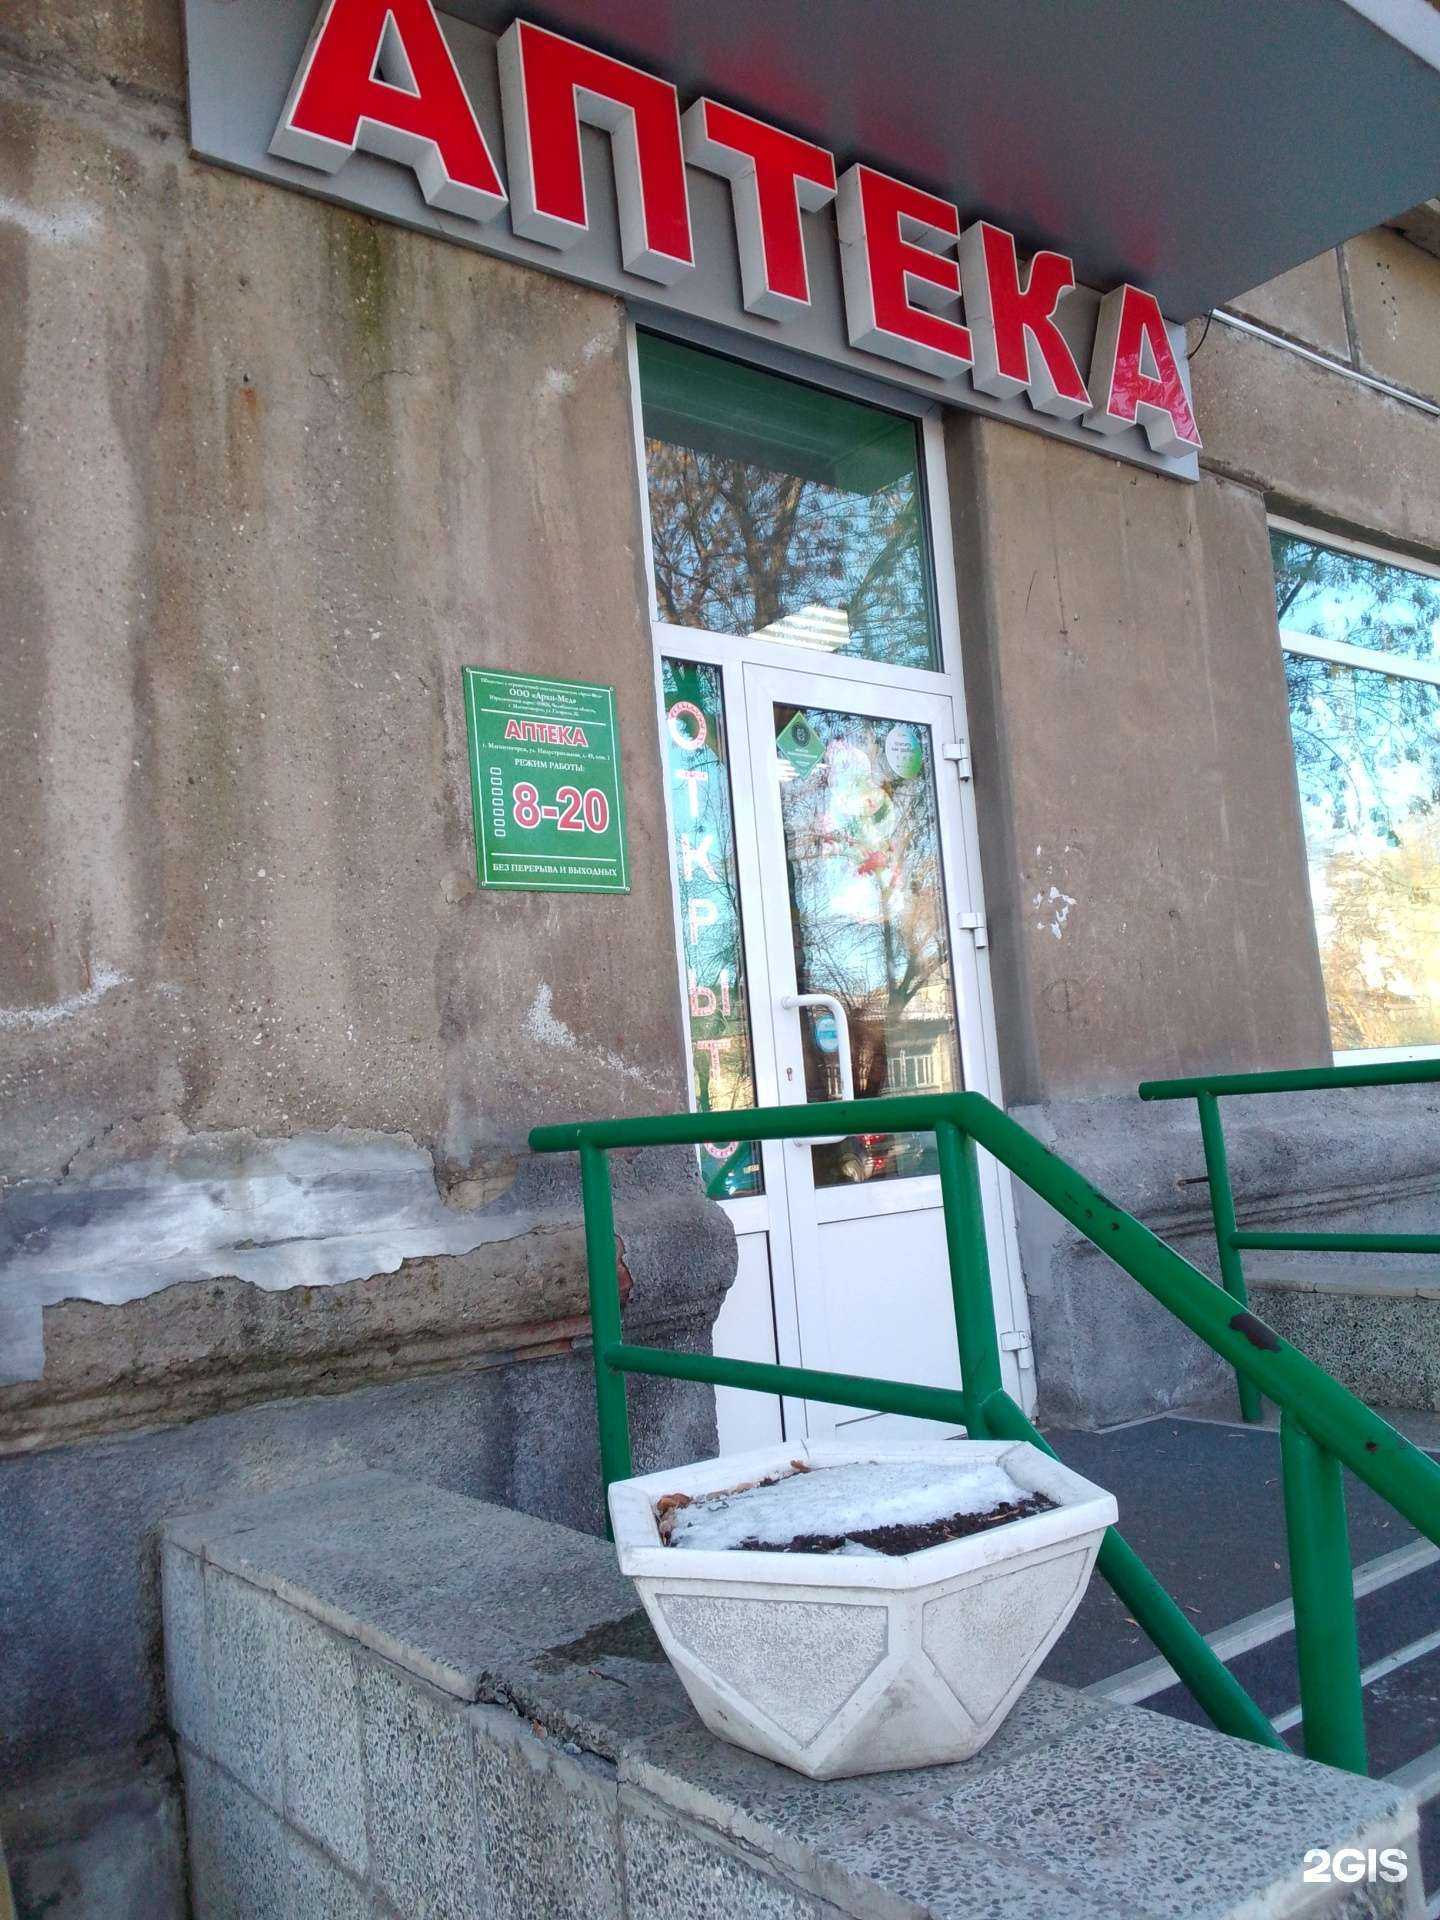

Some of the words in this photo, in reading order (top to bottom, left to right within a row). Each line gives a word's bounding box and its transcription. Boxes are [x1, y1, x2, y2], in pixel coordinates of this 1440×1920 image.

[269, 0, 1202, 457] АПТЕКА
[509, 688, 530, 698] ООО
[505, 719, 589, 747] АПТЕКА
[514, 758, 547, 769] РЕЖИМ
[512, 781, 610, 834] 8-20
[493, 863, 510, 872] БЕЗ
[511, 864, 559, 874] ПЕРЕРЫВА
[560, 866, 567, 874] И
[568, 866, 617, 876] ВЫХОДНЫХ
